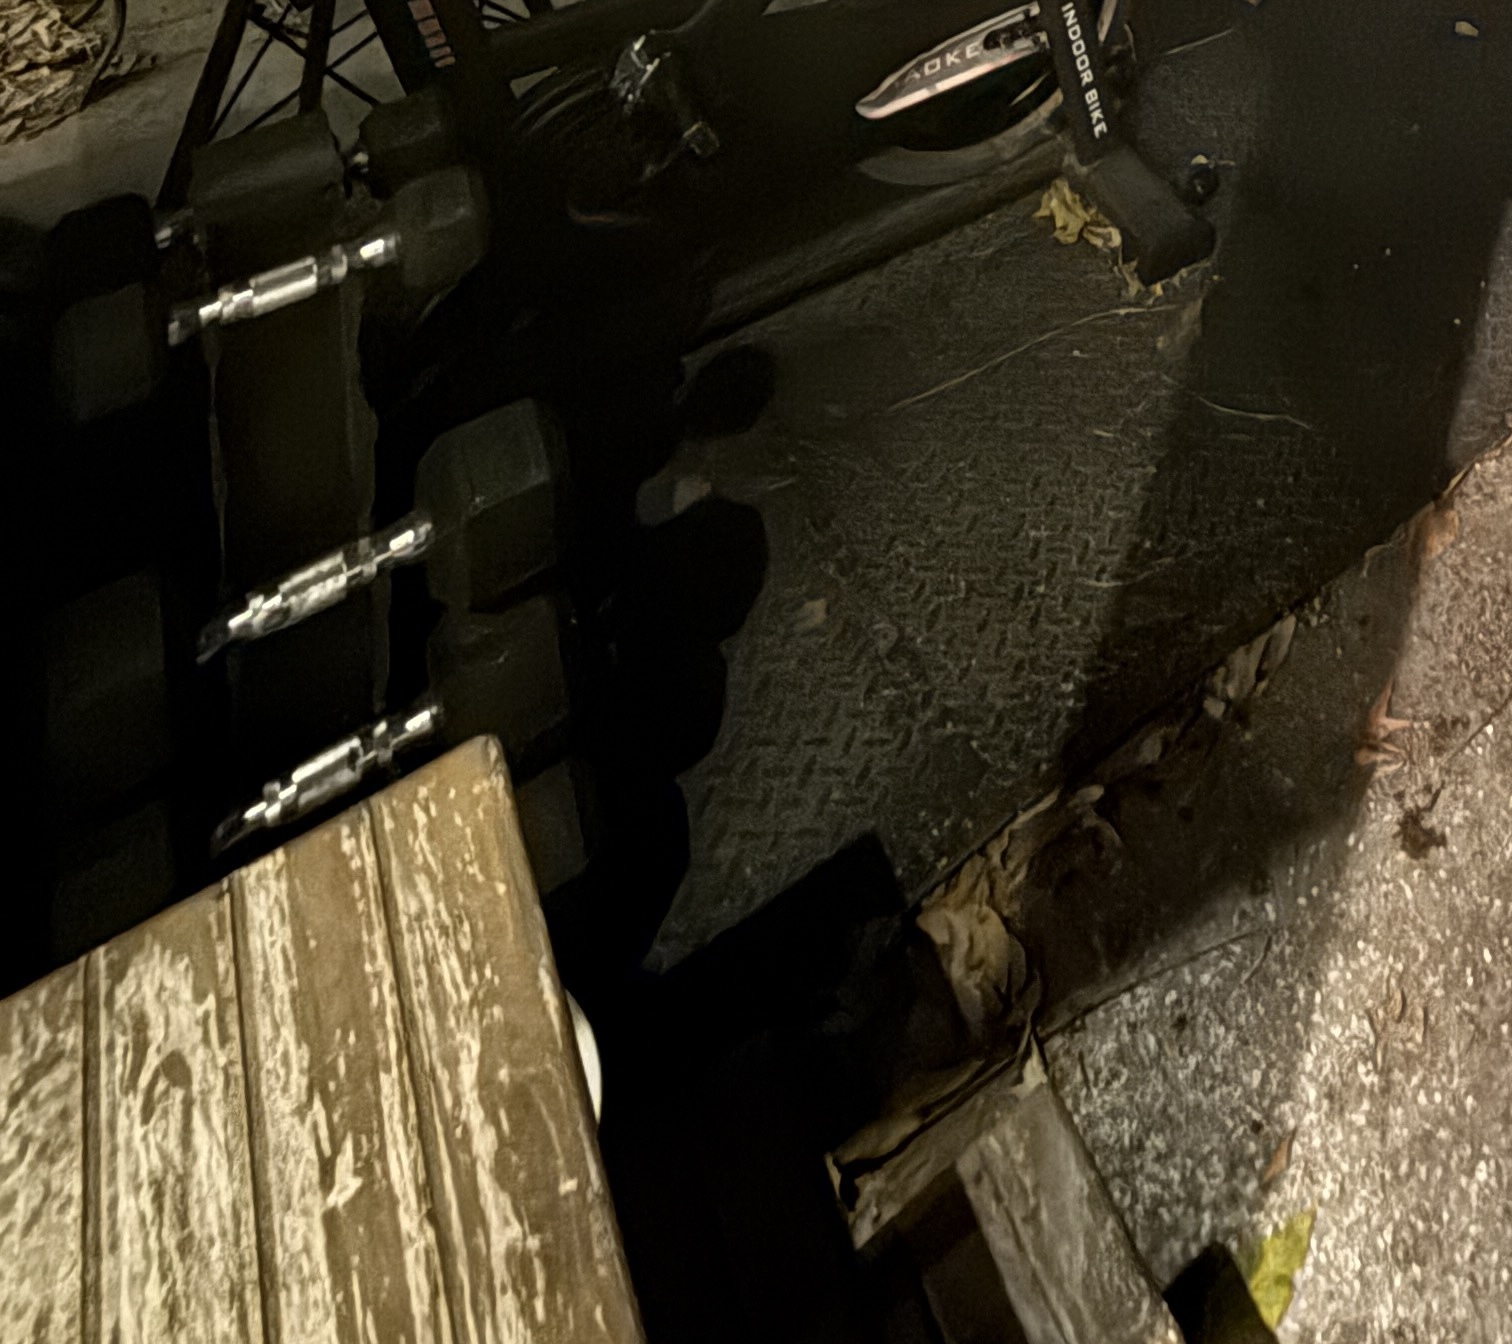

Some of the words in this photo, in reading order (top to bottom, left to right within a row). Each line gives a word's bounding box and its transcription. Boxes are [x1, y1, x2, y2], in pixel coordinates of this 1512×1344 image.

[893, 40, 982, 89] AOKE
[1061, 1, 1094, 87] INDOOR
[1084, 88, 1108, 140] BIKE
